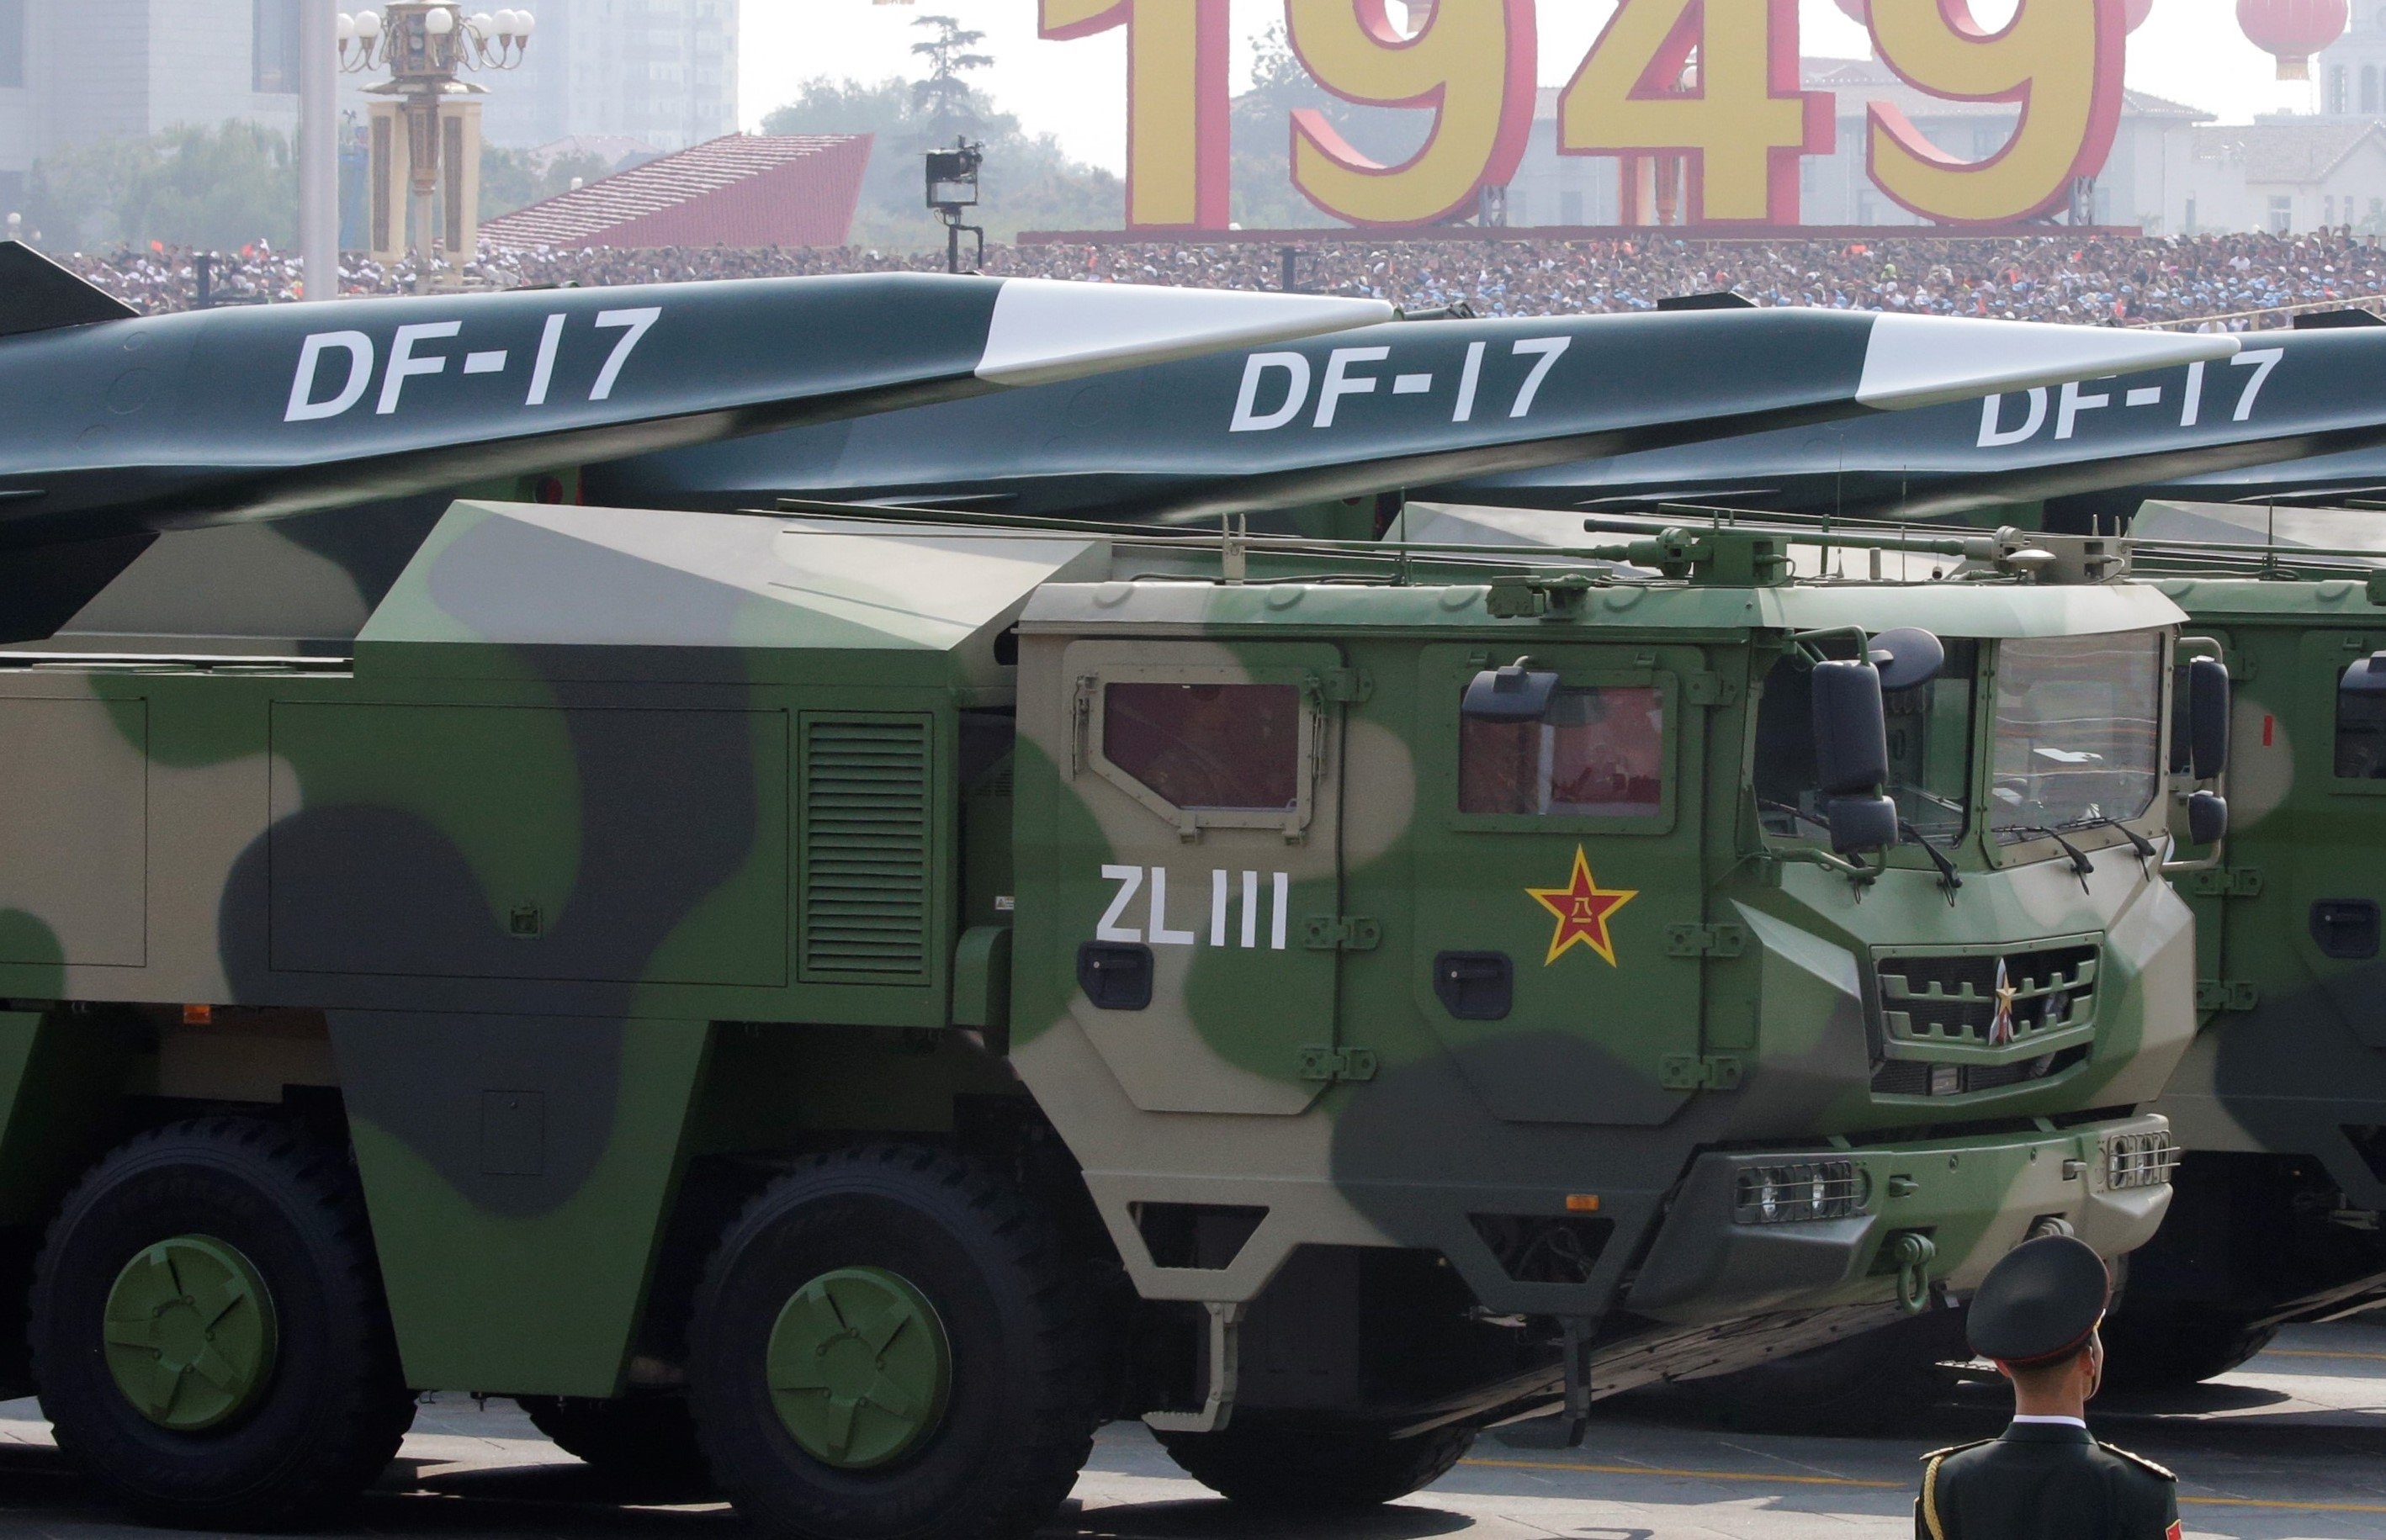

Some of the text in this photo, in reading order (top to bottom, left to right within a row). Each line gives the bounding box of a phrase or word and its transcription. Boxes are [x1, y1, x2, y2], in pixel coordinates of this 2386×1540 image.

[1037, 0, 2128, 229] 1949
[284, 307, 662, 421] DF-17
[1229, 336, 1572, 432] DF-17
[1976, 347, 2285, 447] DF-17
[1096, 865, 1194, 945] ZL
